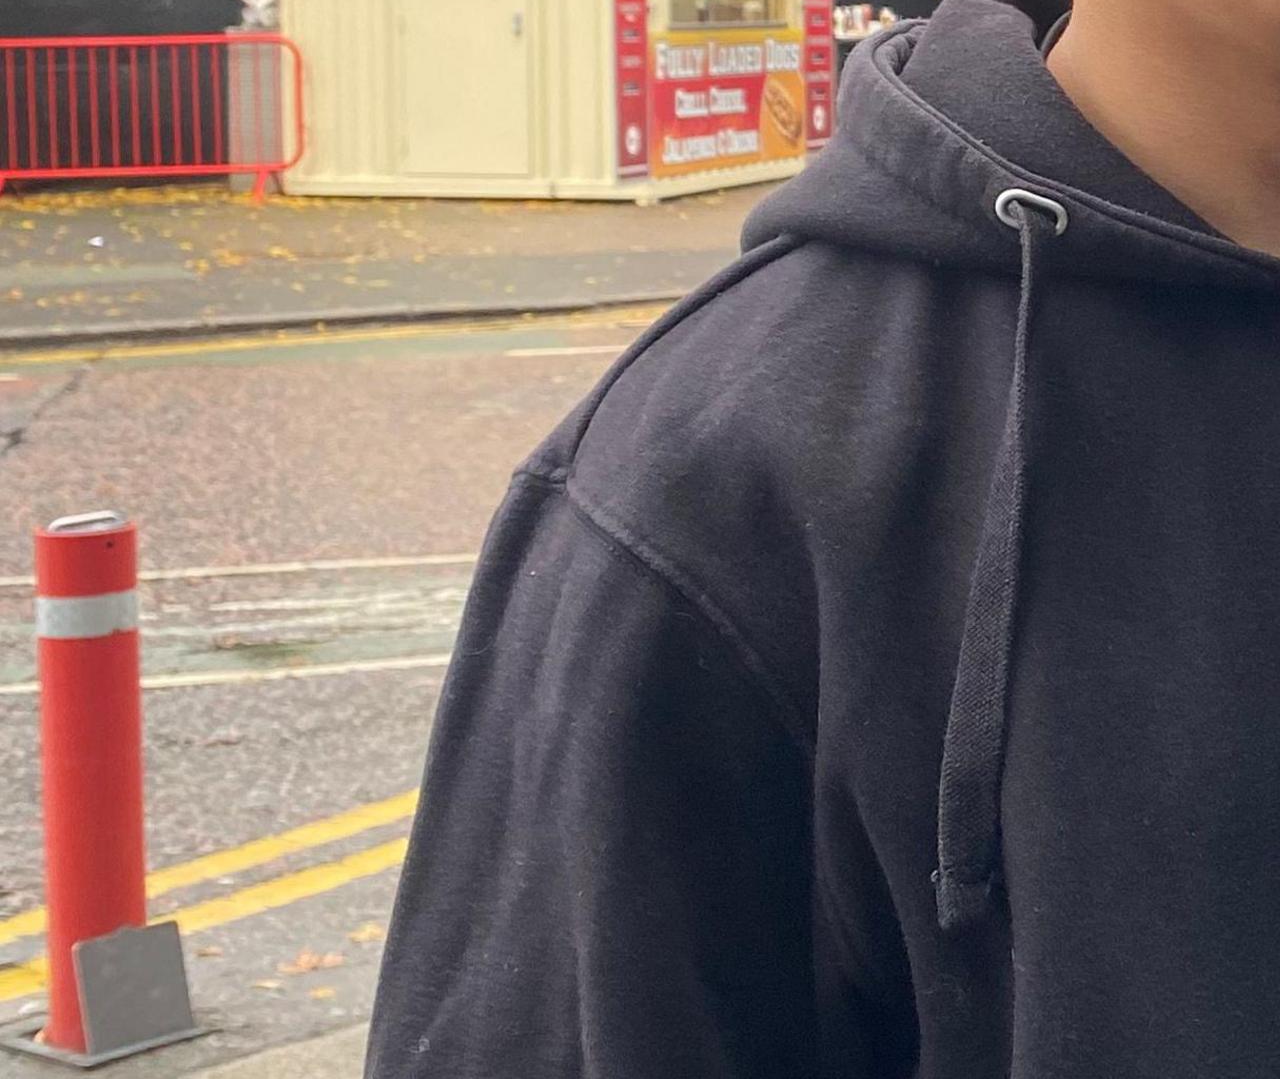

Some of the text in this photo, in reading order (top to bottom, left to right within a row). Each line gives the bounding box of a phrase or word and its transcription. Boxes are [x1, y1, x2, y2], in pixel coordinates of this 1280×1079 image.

[656, 38, 800, 80] FULLY LOADED DOGS
